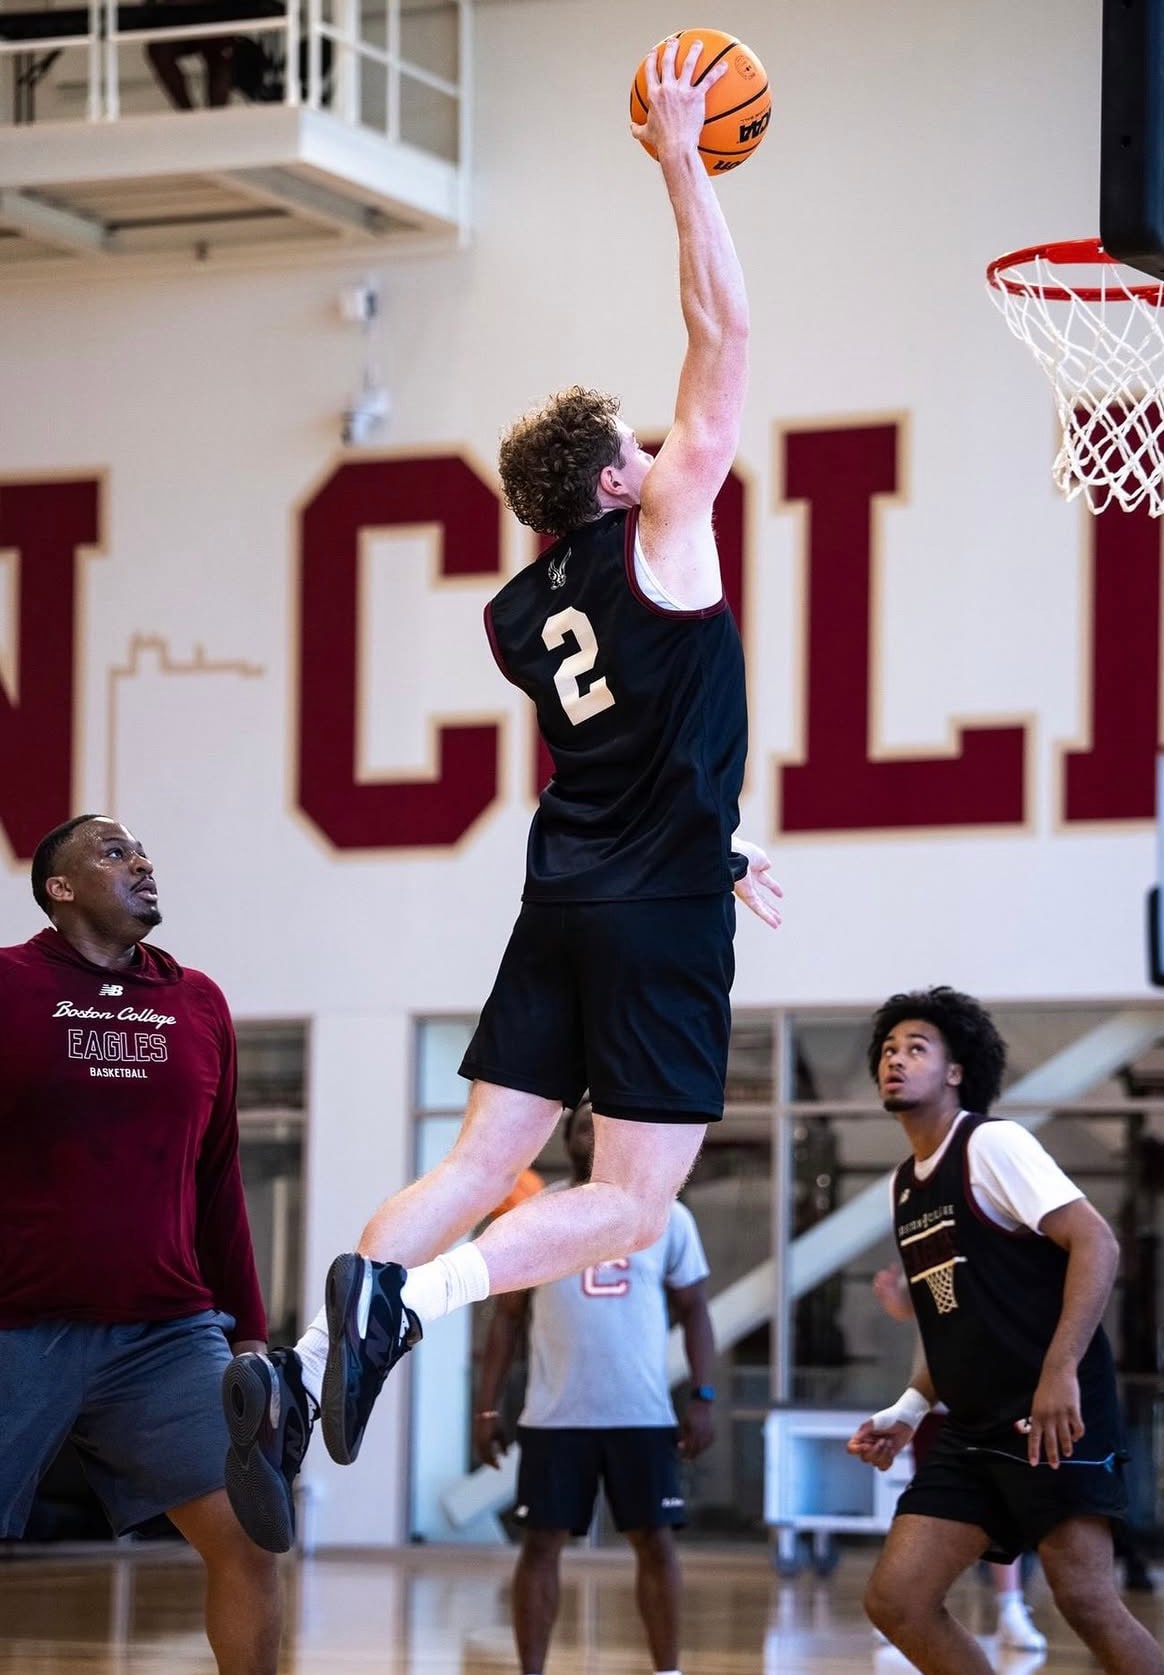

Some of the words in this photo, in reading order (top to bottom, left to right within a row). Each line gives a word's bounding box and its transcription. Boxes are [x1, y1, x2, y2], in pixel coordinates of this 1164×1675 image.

[739, 107, 771, 143] CAA
[541, 606, 615, 726] 2
[52, 1001, 115, 1018] Boston
[117, 1007, 177, 1030] College
[68, 1028, 168, 1063] EAGLES
[89, 1067, 148, 1078] BASKETBALL
